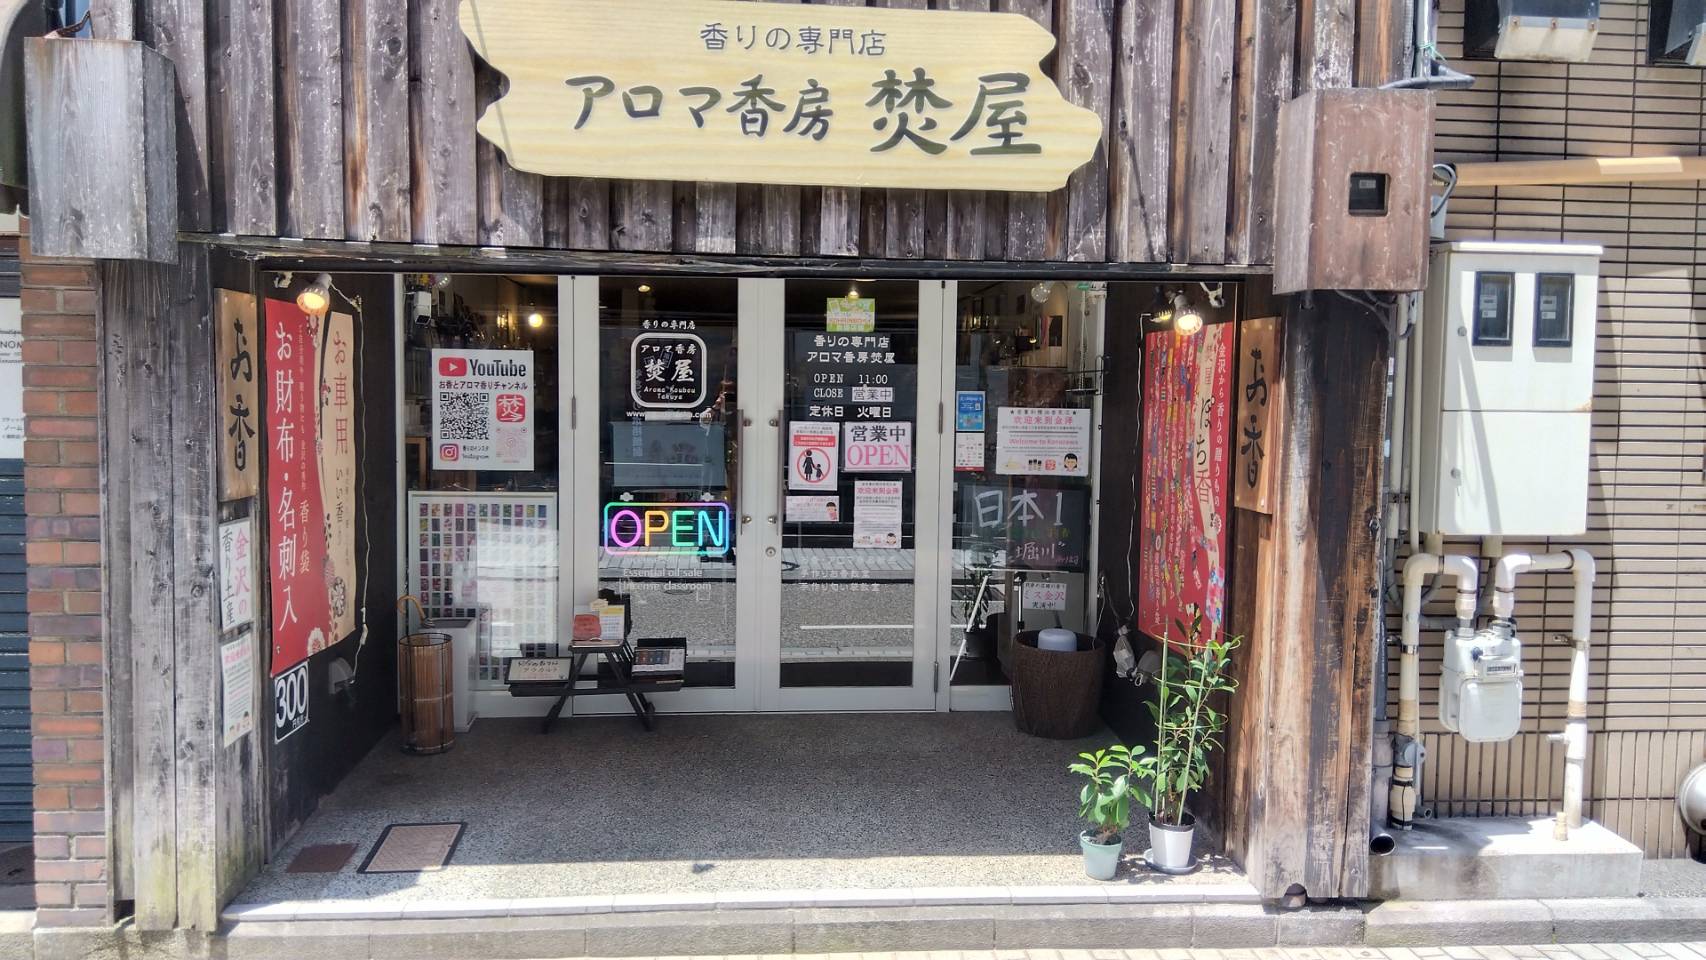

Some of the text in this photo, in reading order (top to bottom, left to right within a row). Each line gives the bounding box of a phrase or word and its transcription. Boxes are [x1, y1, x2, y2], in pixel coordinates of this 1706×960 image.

[699, 22, 887, 56] 香りの専門店
[564, 68, 1043, 156] アロマ香房 焚屋
[642, 320, 697, 330] 香りの専門店
[640, 344, 697, 355] アロマ香房
[814, 335, 891, 348] 香りの専門店
[807, 352, 896, 363] アロマ香房焚屋
[469, 359, 527, 377] YouTube
[644, 358, 695, 382] 焚屋
[814, 373, 888, 385] OPEN 11:00
[230, 318, 256, 472] お香
[813, 388, 844, 398] CLOSE
[809, 406, 892, 418] 定休日 火曜日
[851, 425, 906, 442] 営業中
[847, 444, 910, 466] OPEN
[275, 321, 299, 631] お財布・名刺入
[611, 510, 723, 547] OPEN
[276, 668, 307, 728] 300
